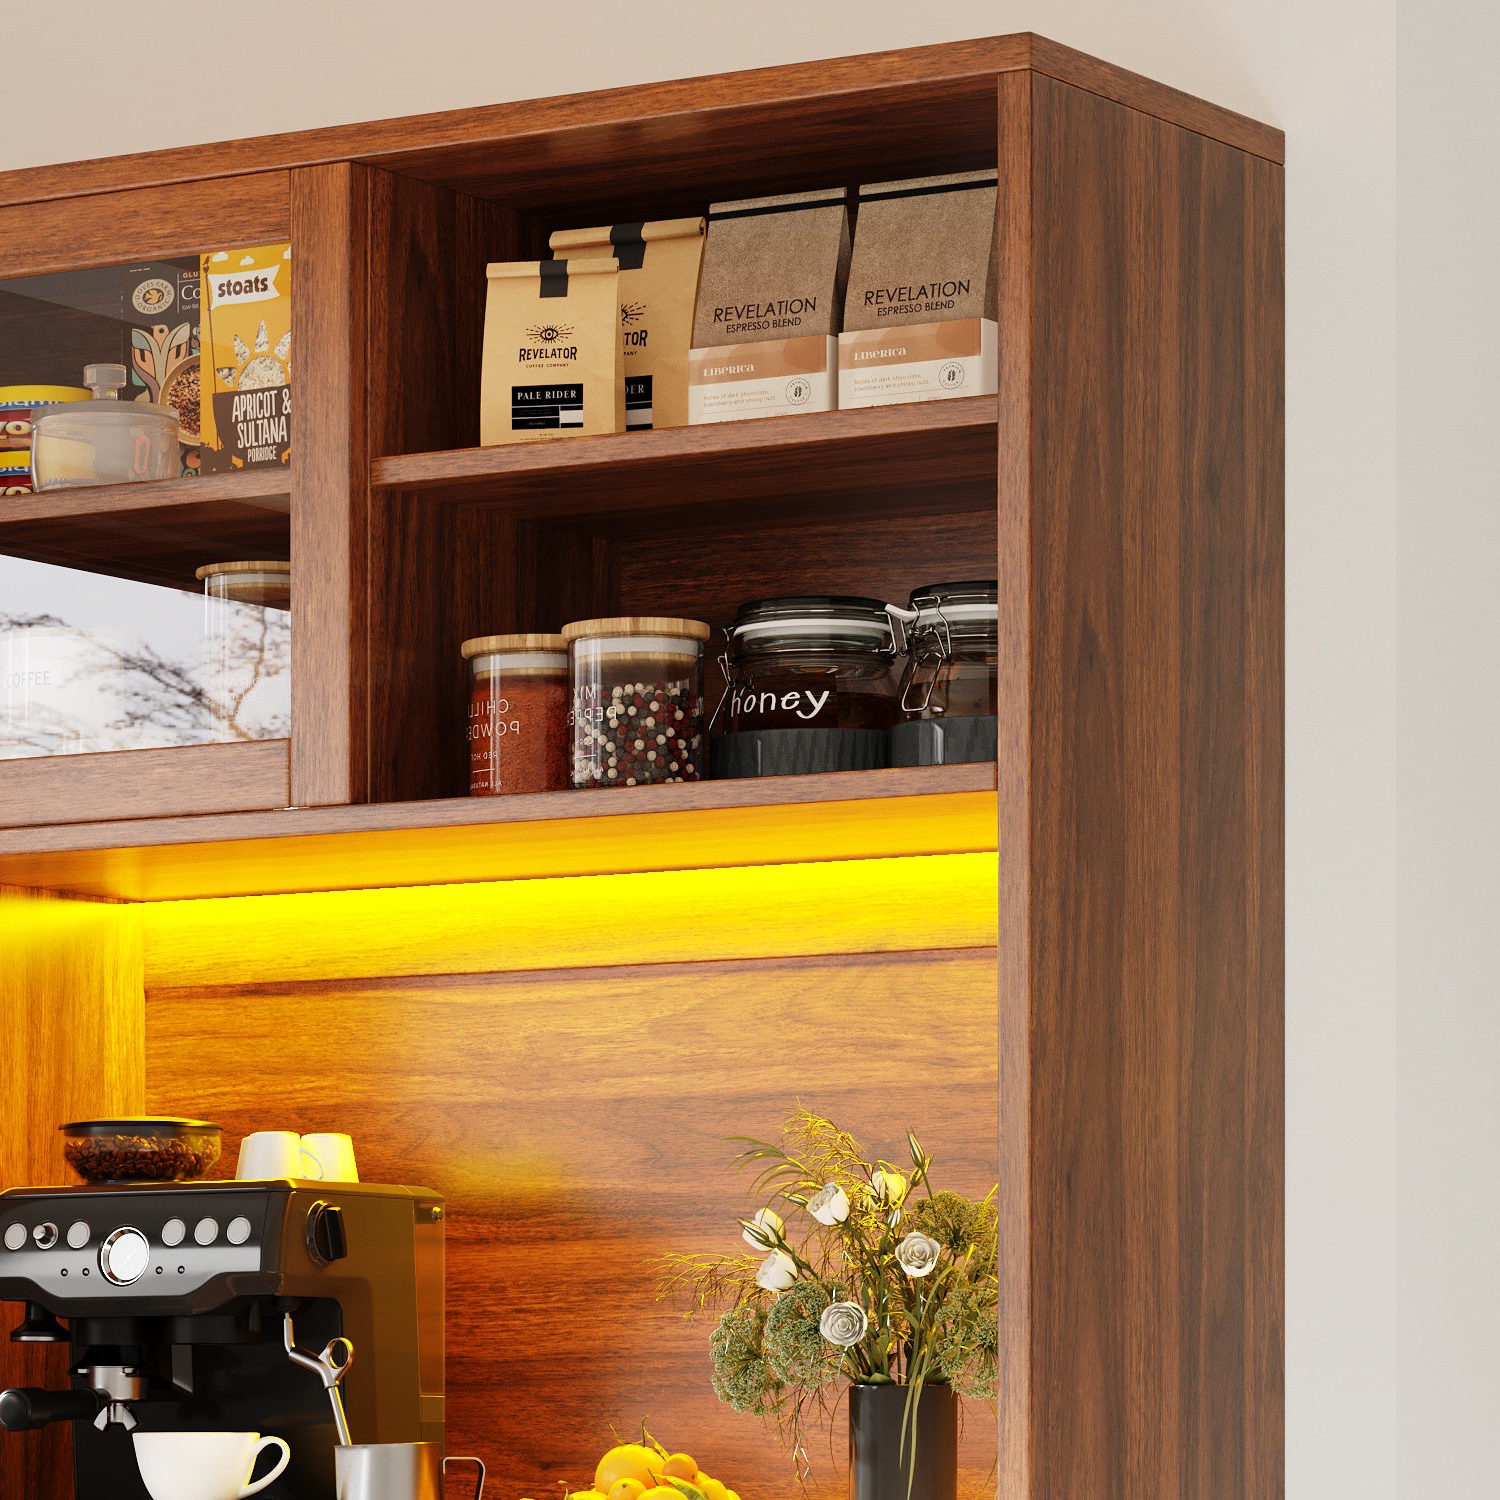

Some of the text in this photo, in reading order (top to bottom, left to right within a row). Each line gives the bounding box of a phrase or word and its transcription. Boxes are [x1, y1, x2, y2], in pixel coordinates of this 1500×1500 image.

[134, 281, 155, 300] DOVES
[218, 275, 269, 298] stoats
[864, 279, 970, 306] REVELATION
[138, 299, 171, 313] ORGANIC
[713, 296, 817, 323] REVELATION
[877, 299, 955, 317] ESPRESSO BLEND
[726, 317, 802, 334] ESPRESSO BLEND
[518, 346, 578, 362] REVELATOR
[517, 389, 577, 401] PALE RIDER
[231, 390, 278, 423] APRICOT
[237, 415, 288, 449] SULTANA
[247, 445, 277, 463] PORRIDGE
[7, 671, 52, 688] COFFEE
[731, 689, 830, 719] honey
